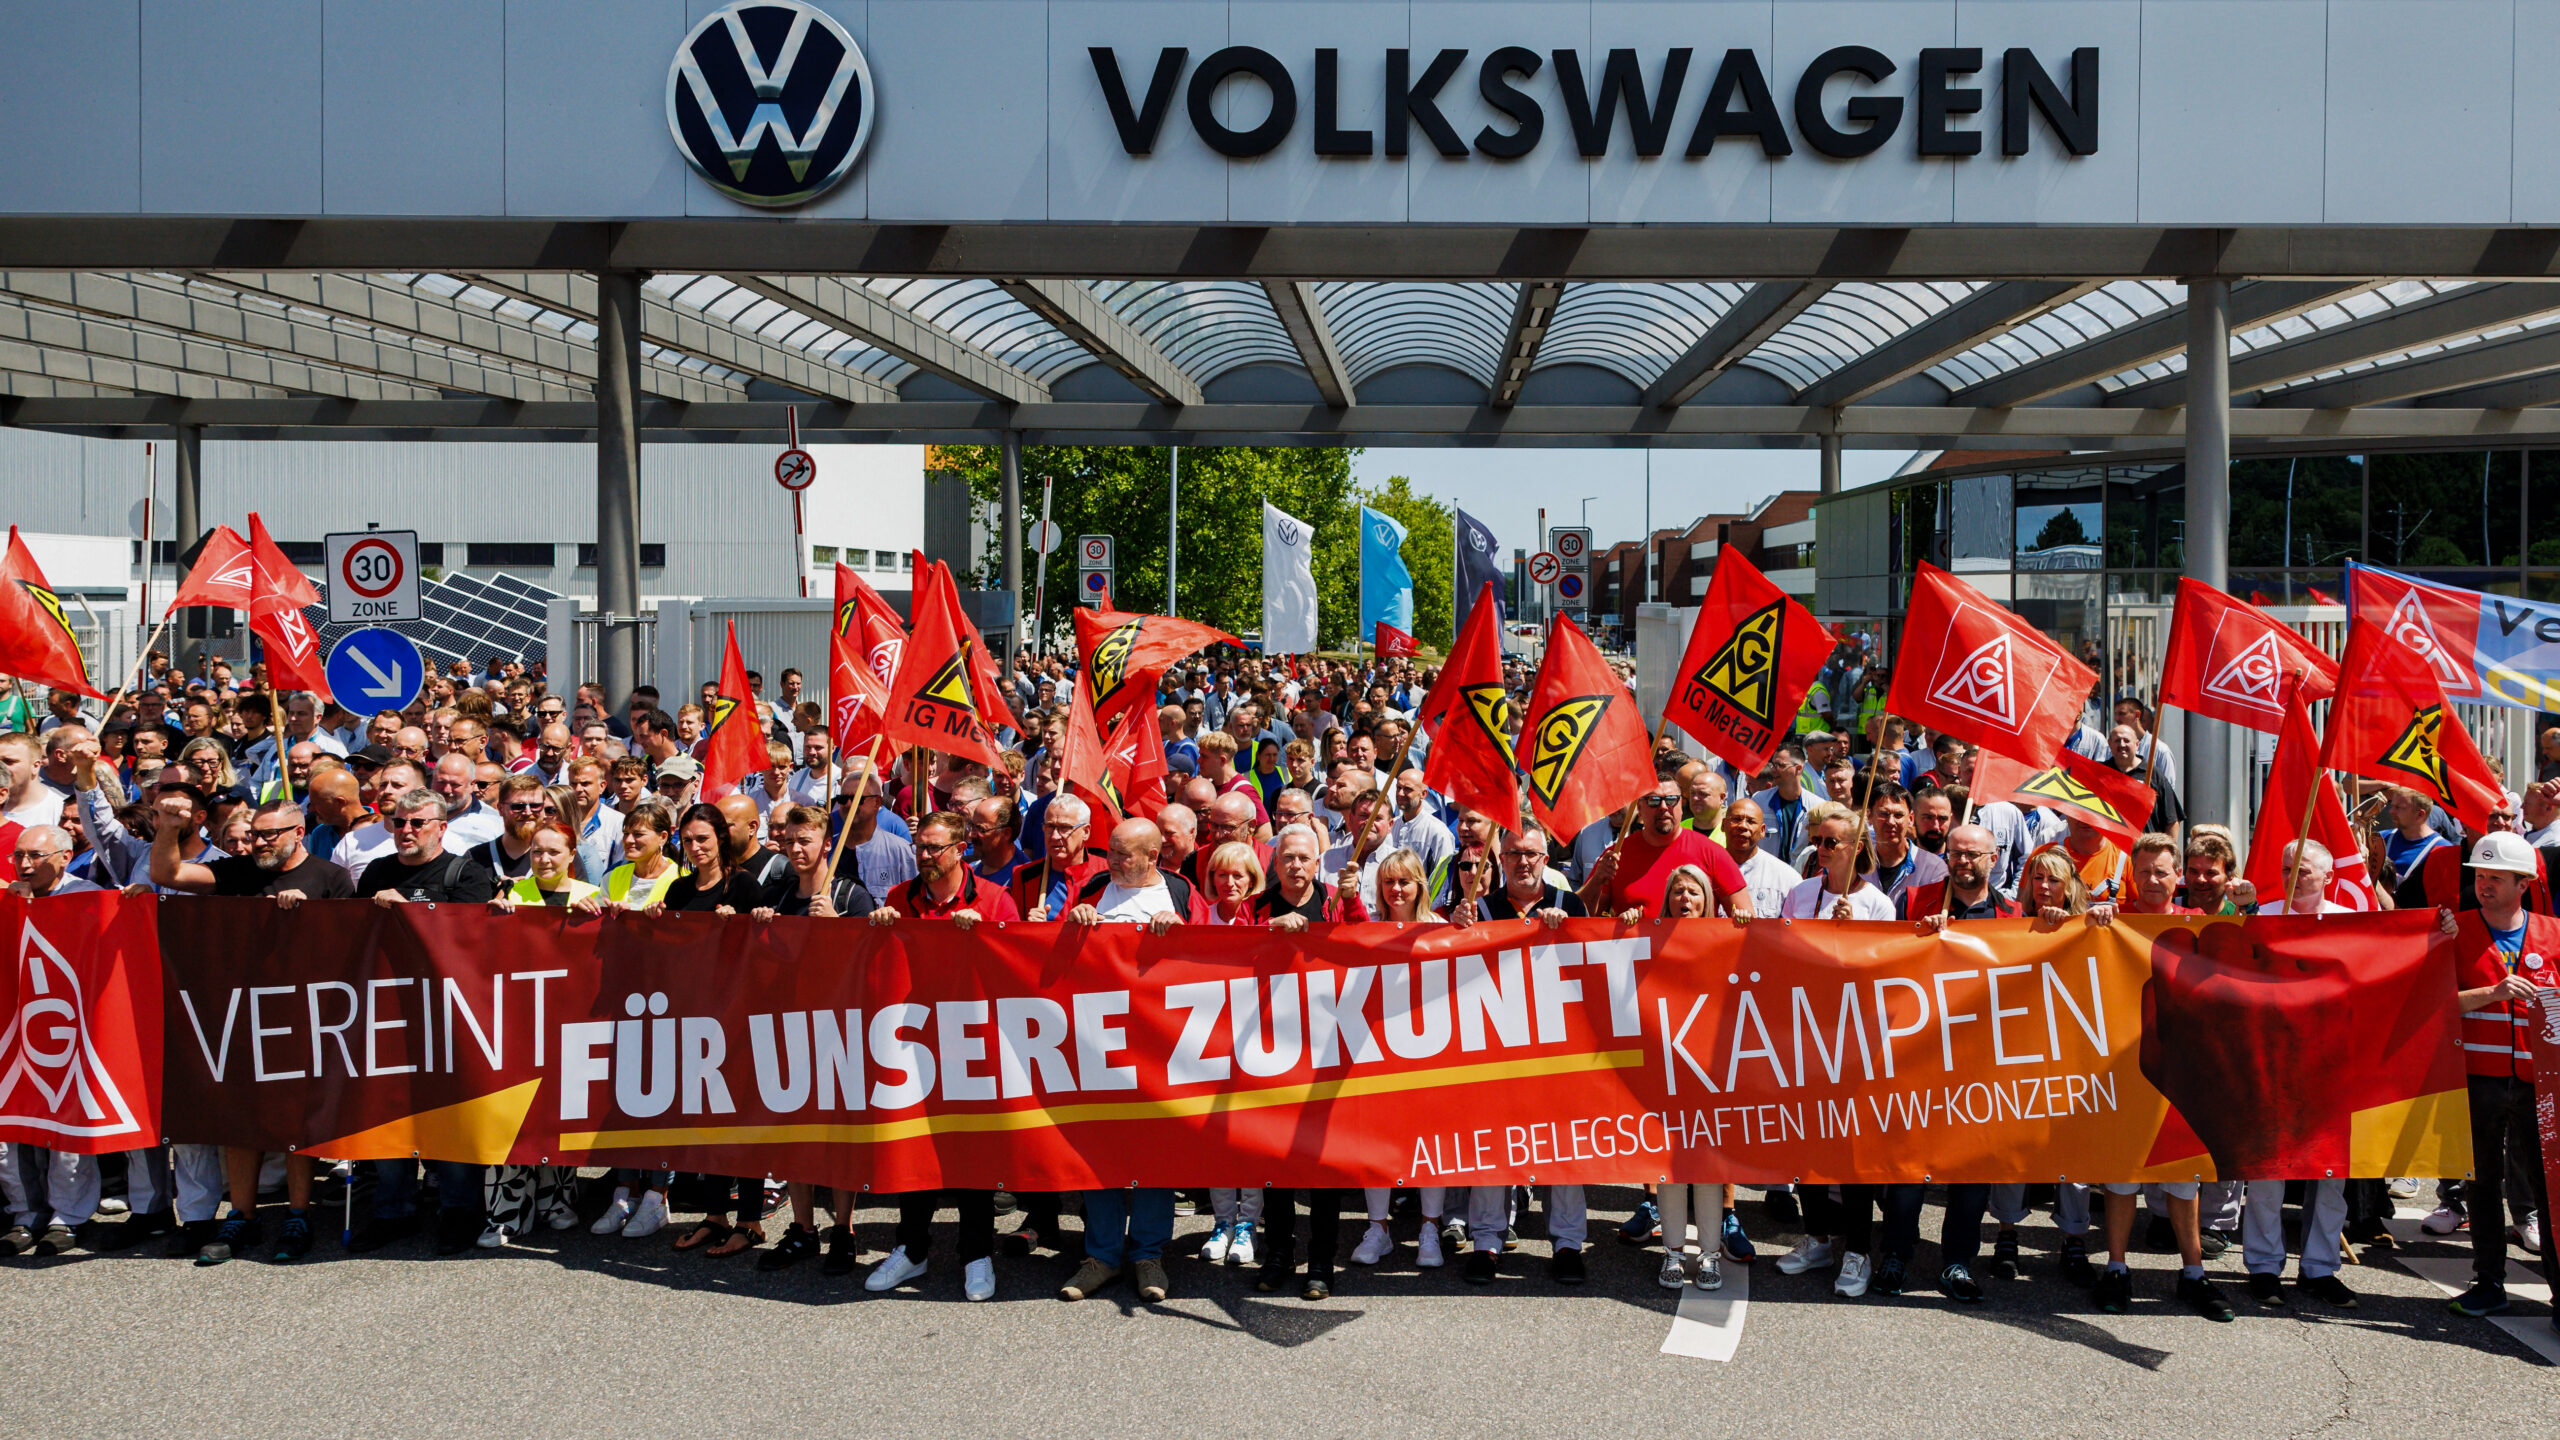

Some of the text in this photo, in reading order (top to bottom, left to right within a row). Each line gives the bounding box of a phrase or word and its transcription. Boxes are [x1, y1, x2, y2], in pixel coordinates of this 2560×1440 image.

[1088, 46, 2098, 164] VOLKSWAGEN
[1090, 545, 1102, 555] 30
[1564, 539, 1578, 551] 30
[355, 555, 391, 582] 30
[352, 601, 398, 617] ZONE
[904, 700, 936, 729] IG
[1682, 683, 1772, 754] IG Metall
[180, 936, 2110, 1121] VEREINT FÜR UNSERE ZUKUNFT KÄMPFEN
[1411, 1071, 2117, 1179] ALLE BELEGSCHAFTEN IM VW-KONZERN
